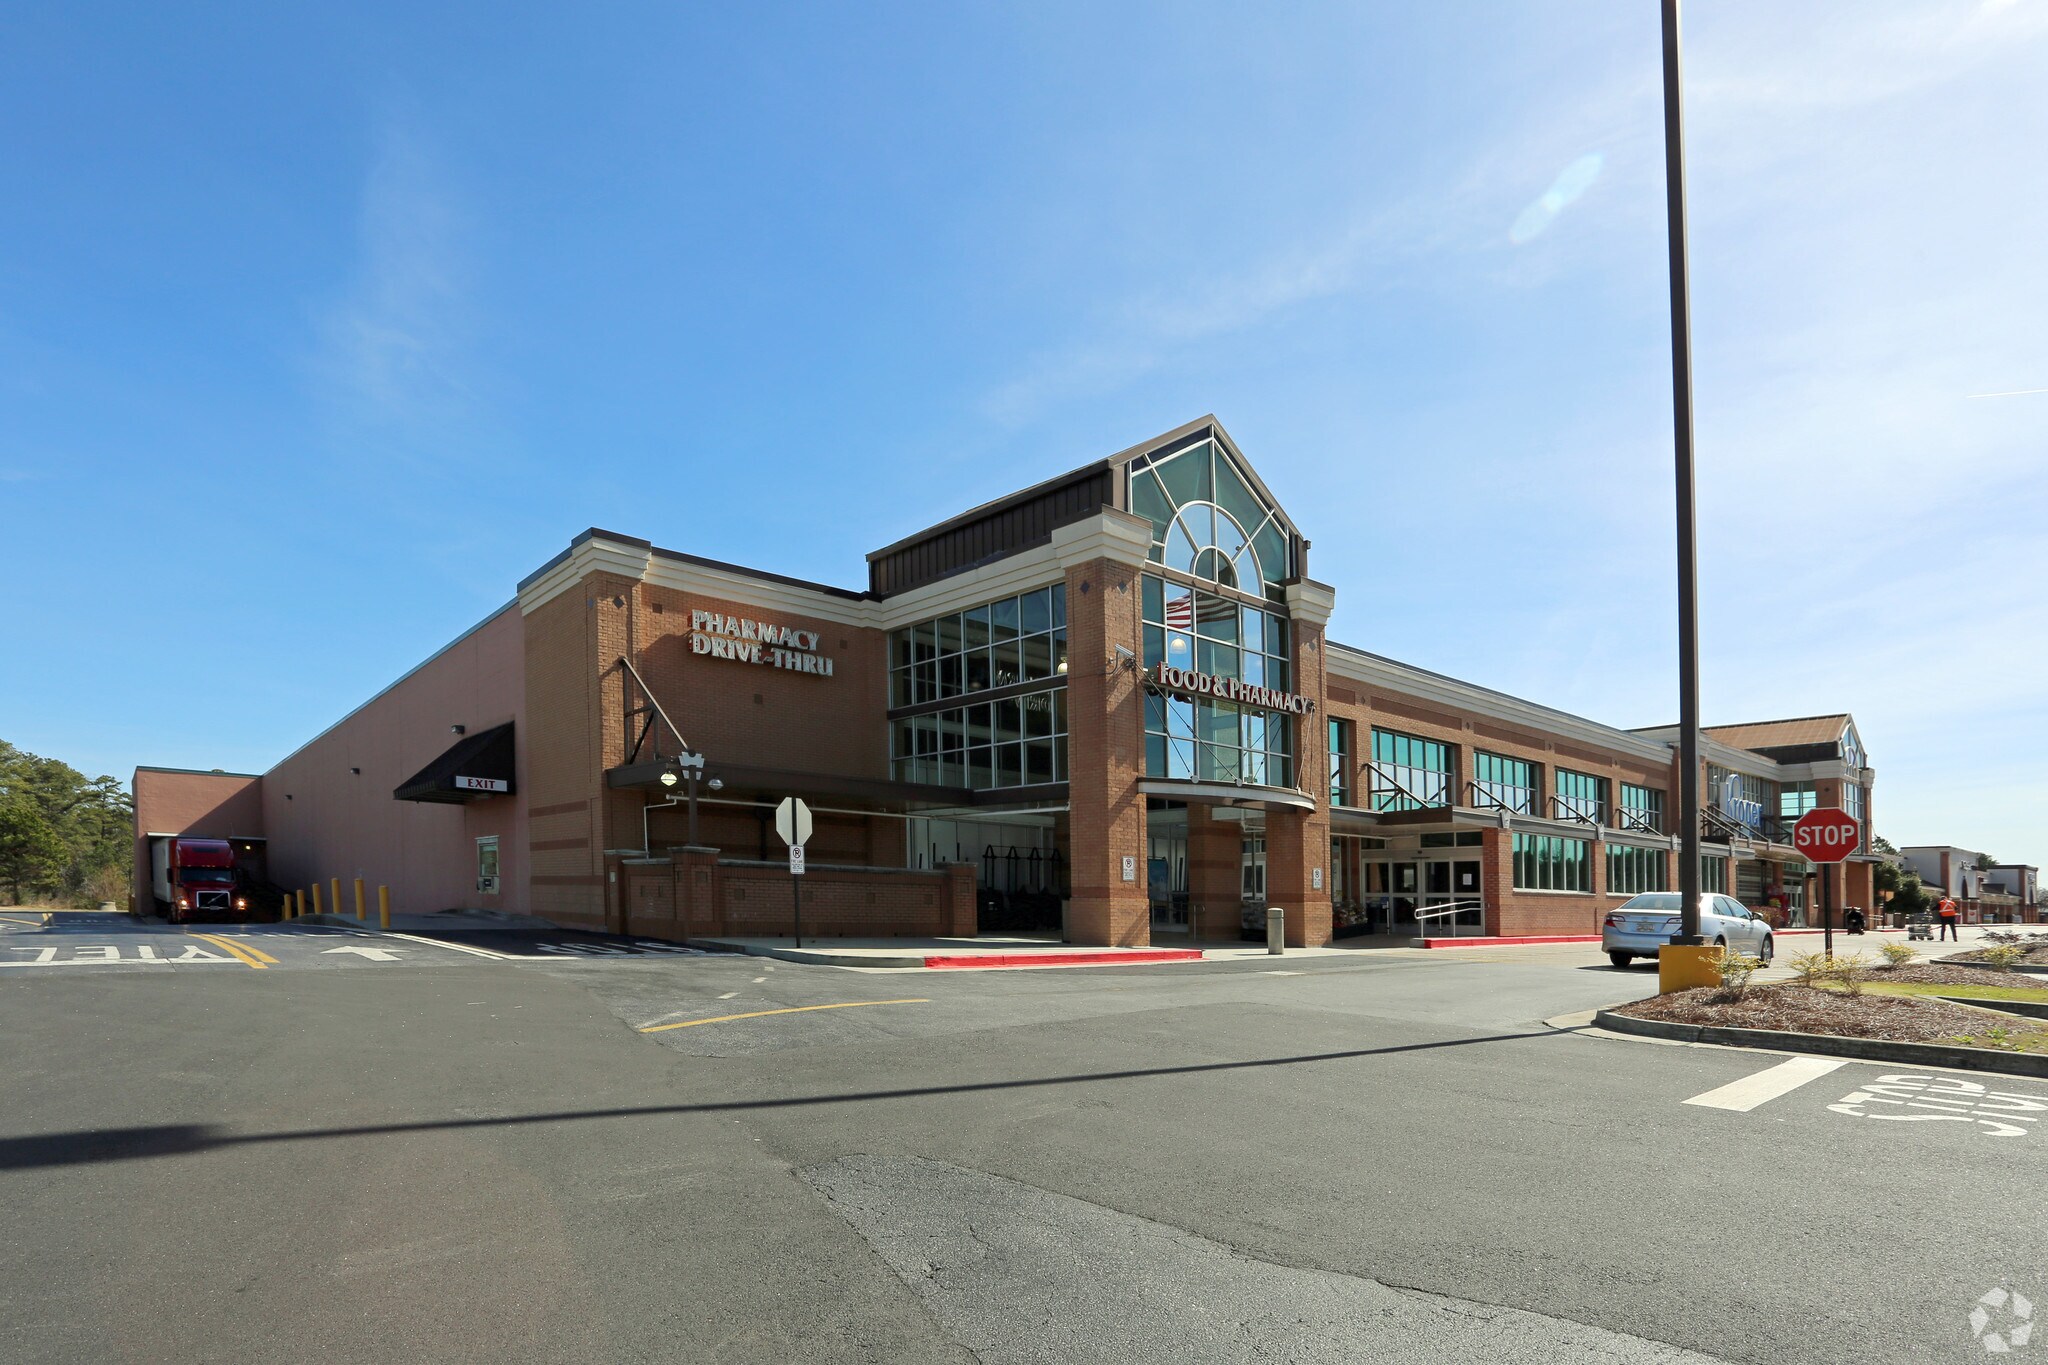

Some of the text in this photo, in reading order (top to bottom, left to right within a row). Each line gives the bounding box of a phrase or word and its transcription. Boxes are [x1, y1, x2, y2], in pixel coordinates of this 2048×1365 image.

[690, 608, 820, 651] PHARMACY
[690, 632, 834, 677] DRIVE-THRU
[1159, 661, 1310, 715] FOOD & PHARMACY
[467, 778, 496, 790] EXIT
[1797, 824, 1855, 846] STOP
[1825, 1074, 2048, 1137] STOP
